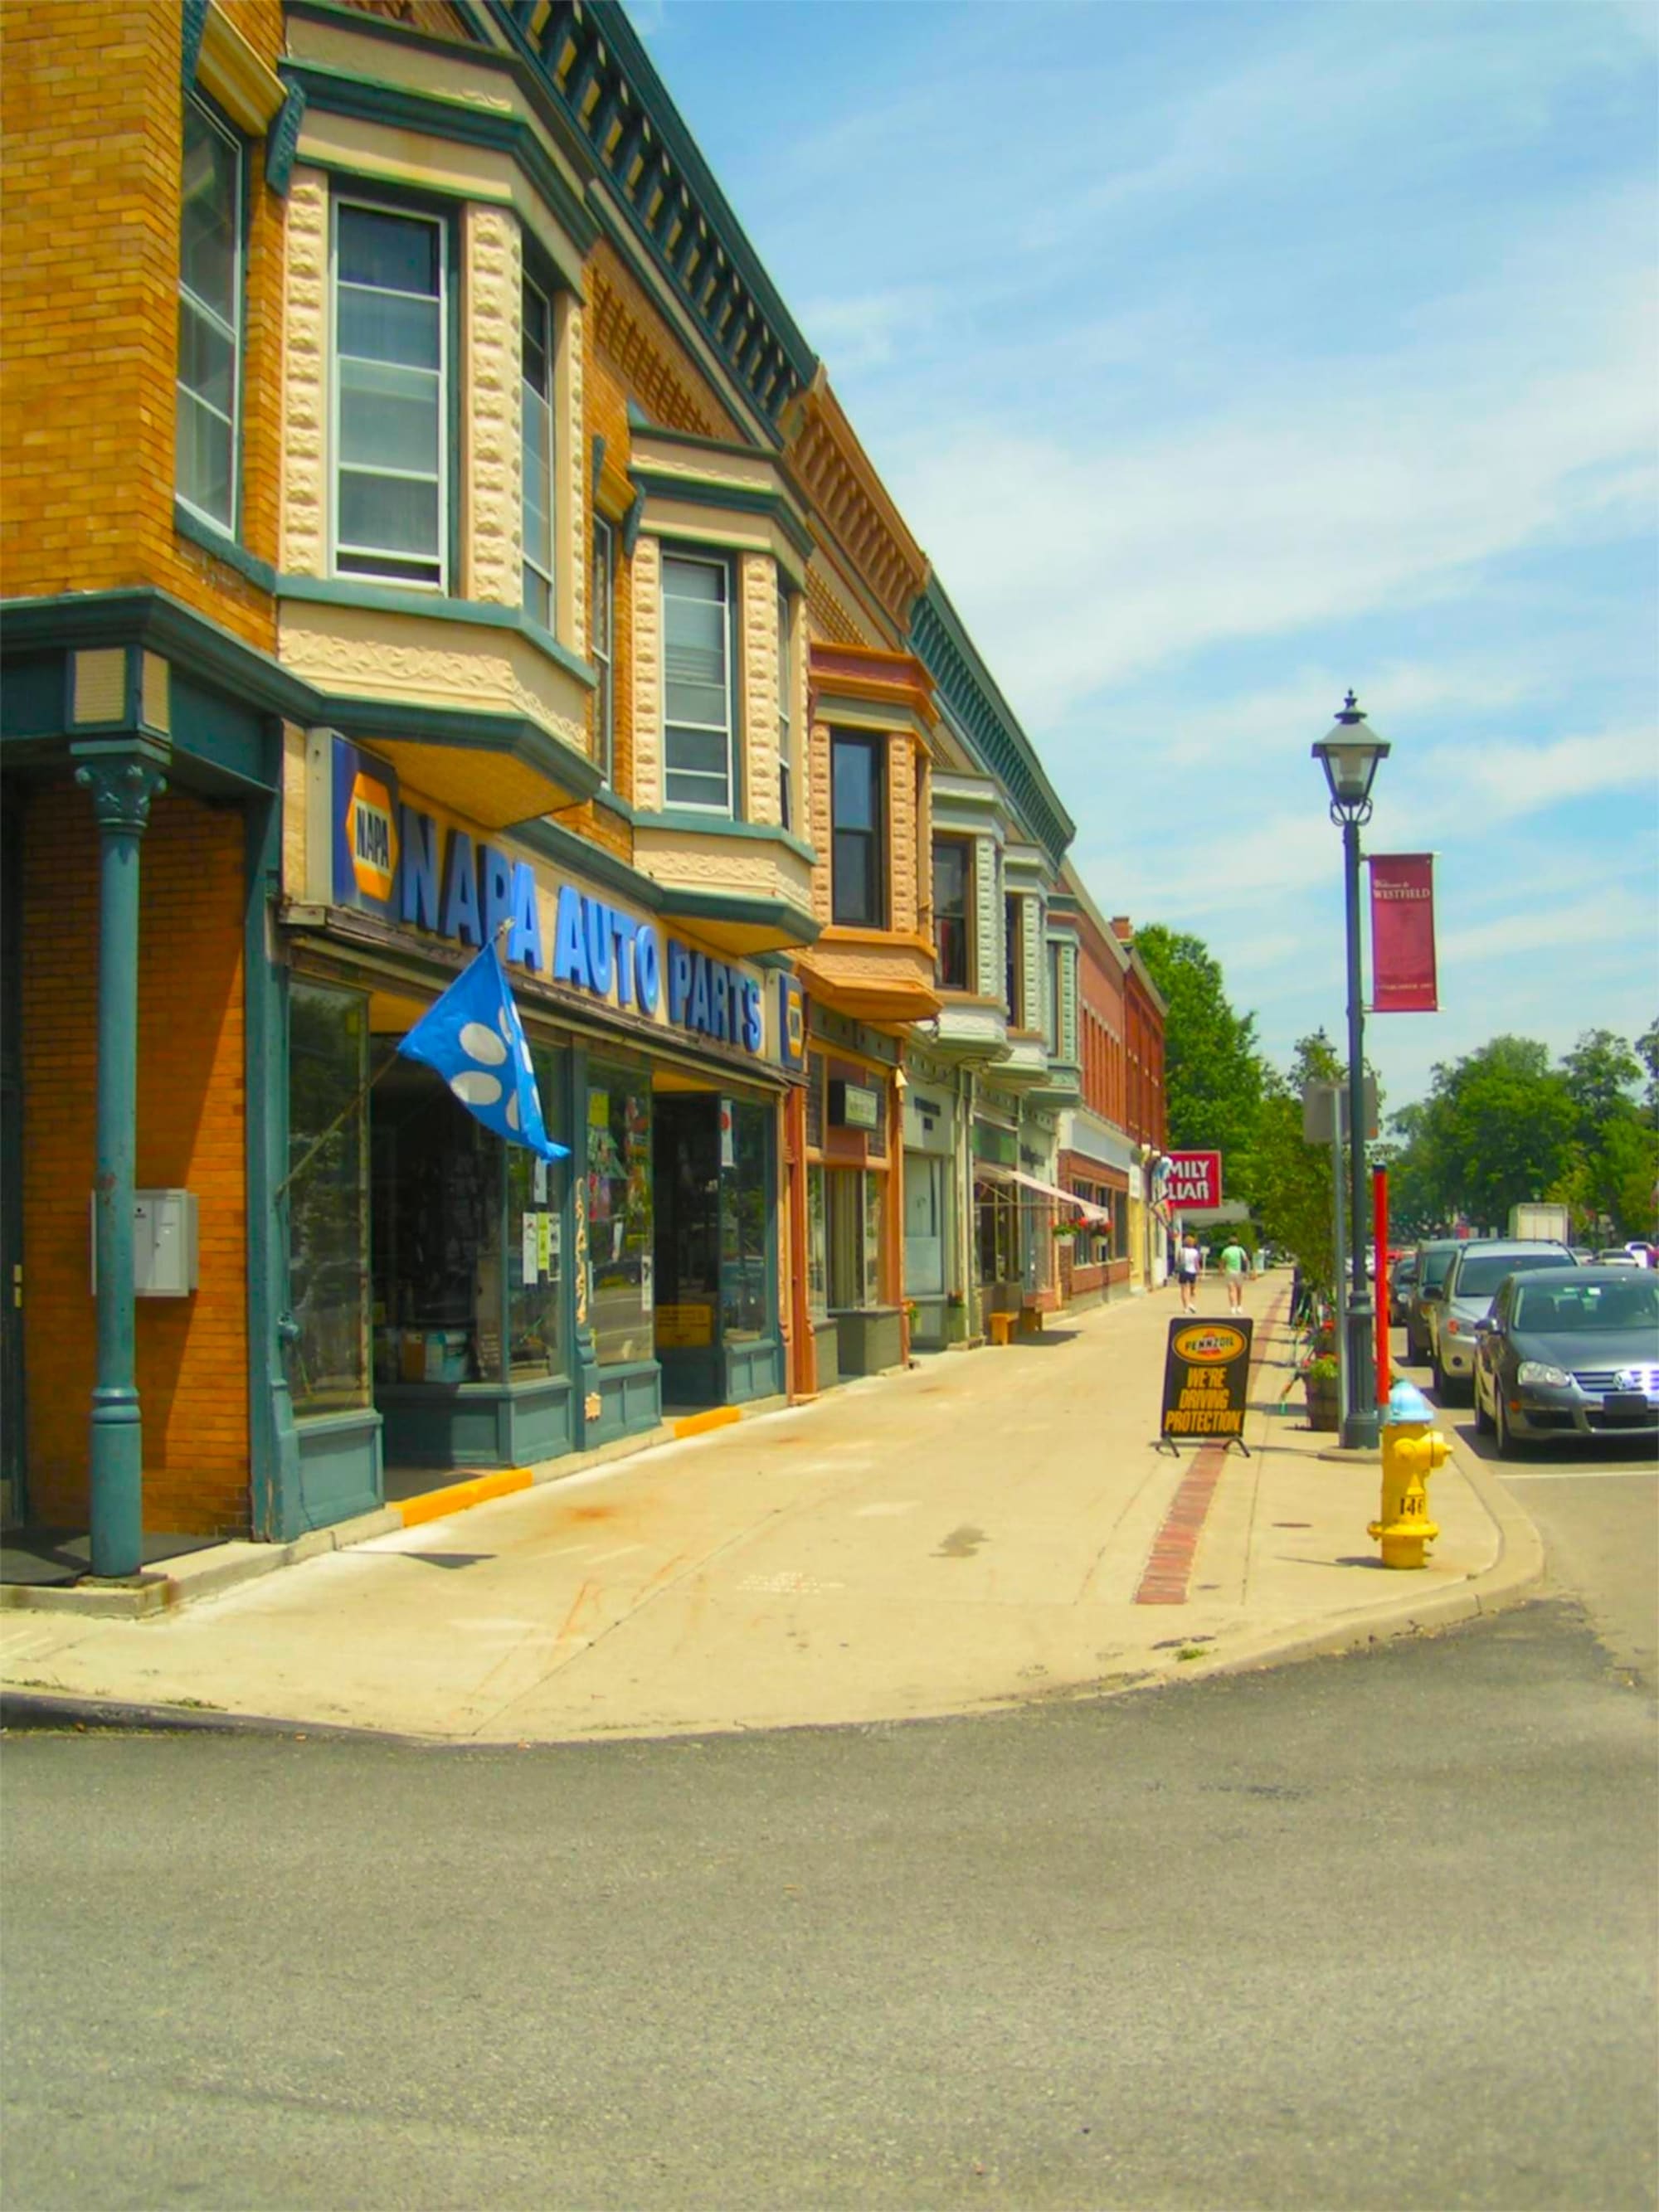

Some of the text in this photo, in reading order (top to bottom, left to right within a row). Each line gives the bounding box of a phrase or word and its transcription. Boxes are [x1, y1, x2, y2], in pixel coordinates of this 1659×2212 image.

[356, 805, 390, 870] NAPA
[400, 802, 761, 1053] NAPA AUTO PARTS
[1170, 1160, 1209, 1178] MILY
[1185, 1337, 1234, 1349] PENNZOIL
